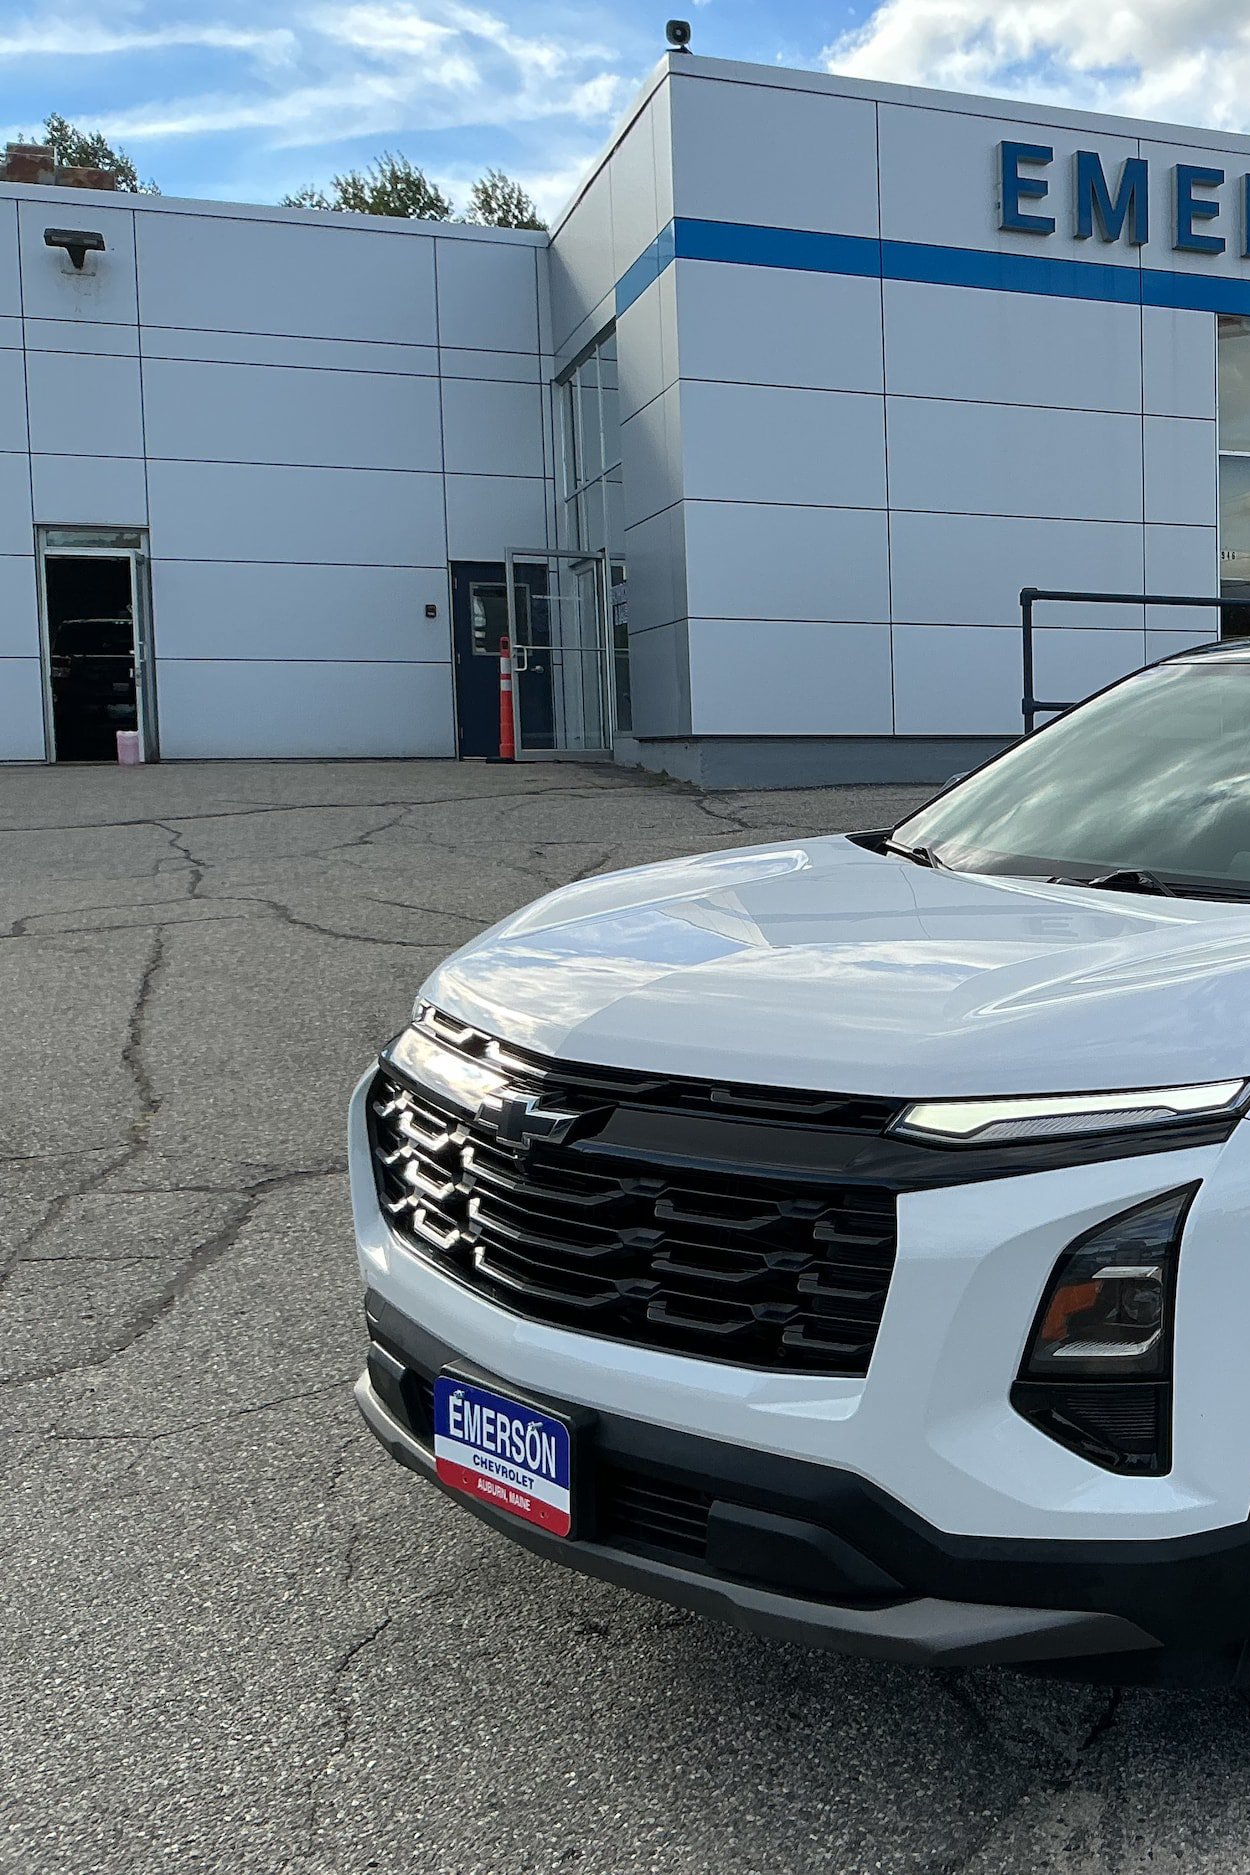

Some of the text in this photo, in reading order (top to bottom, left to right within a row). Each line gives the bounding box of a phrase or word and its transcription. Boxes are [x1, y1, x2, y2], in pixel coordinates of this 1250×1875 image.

[449, 1394, 556, 1479] EMERSON
[472, 1454, 535, 1490] CHEVROLET
[508, 1490, 532, 1512] MAINE
